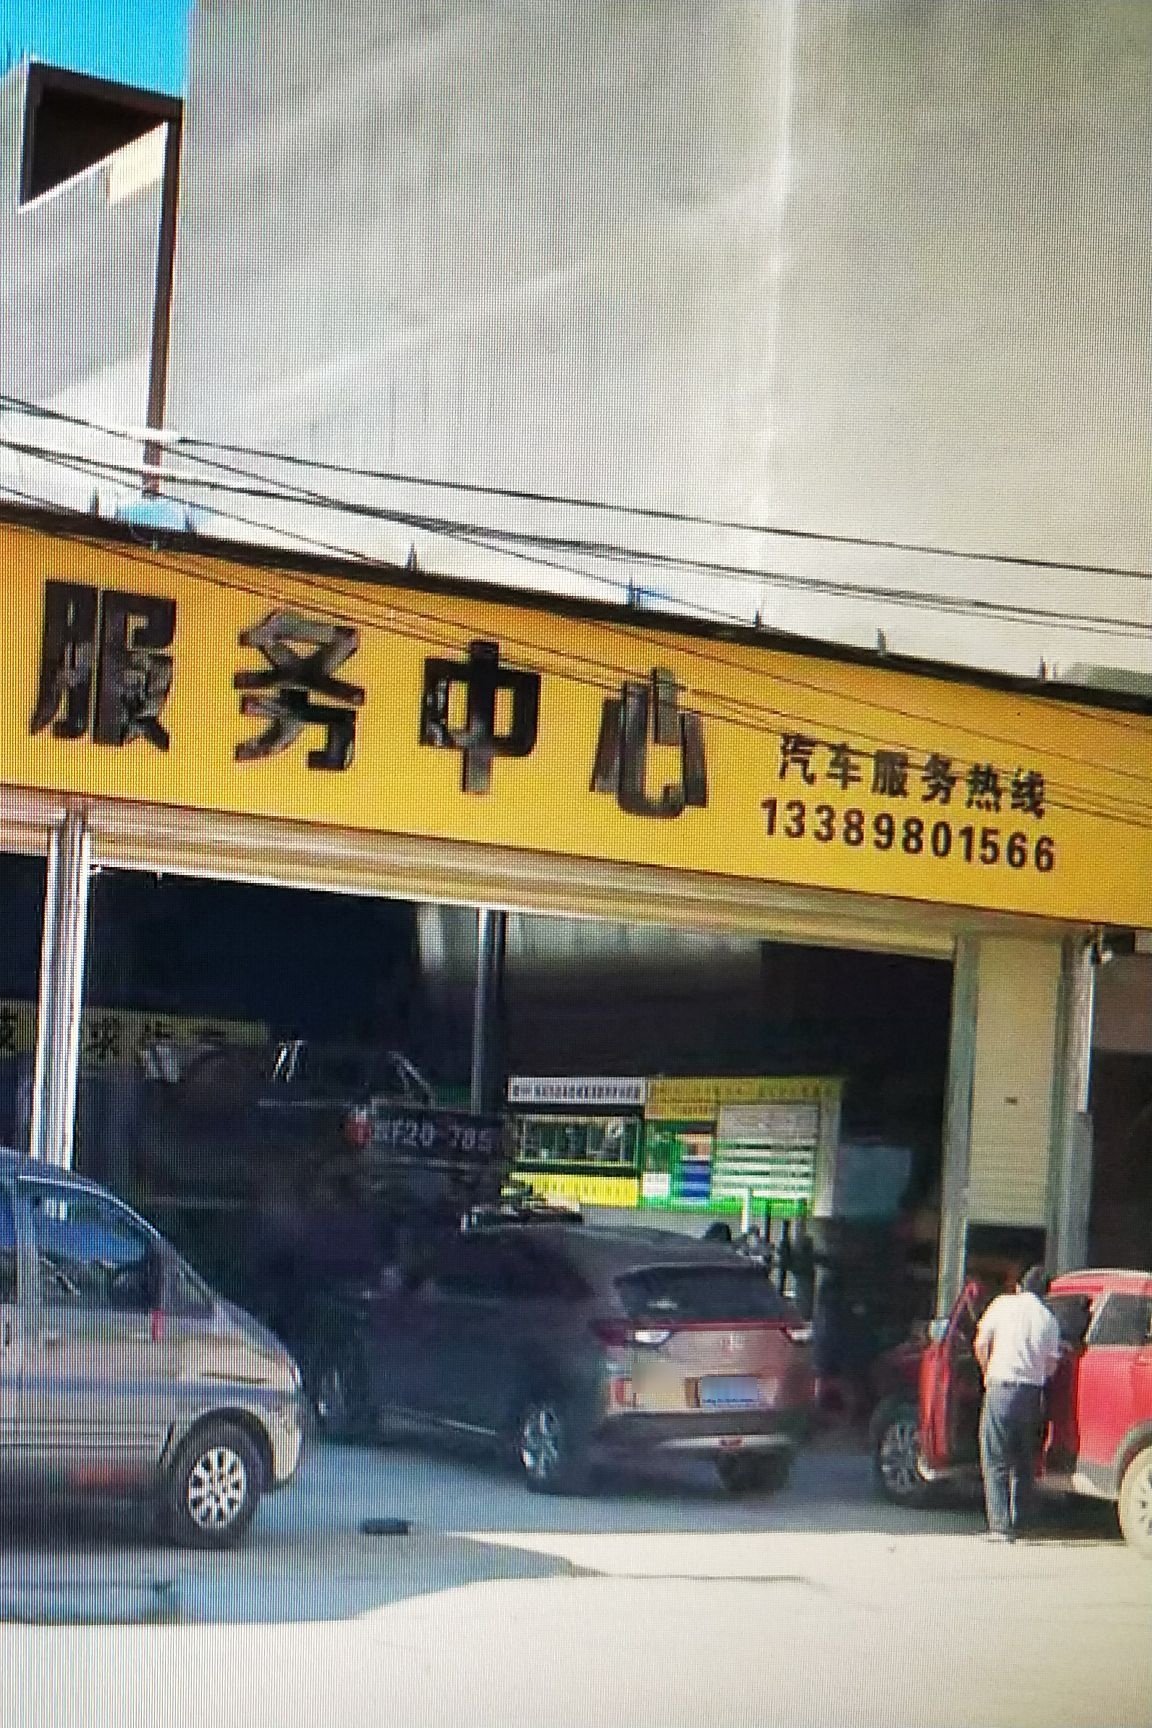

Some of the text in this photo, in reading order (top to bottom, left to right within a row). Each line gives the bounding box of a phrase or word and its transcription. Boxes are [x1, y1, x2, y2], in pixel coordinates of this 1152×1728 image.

[777, 732, 1046, 820] 汽车服务热线
[759, 797, 1056, 873] 13389801566
